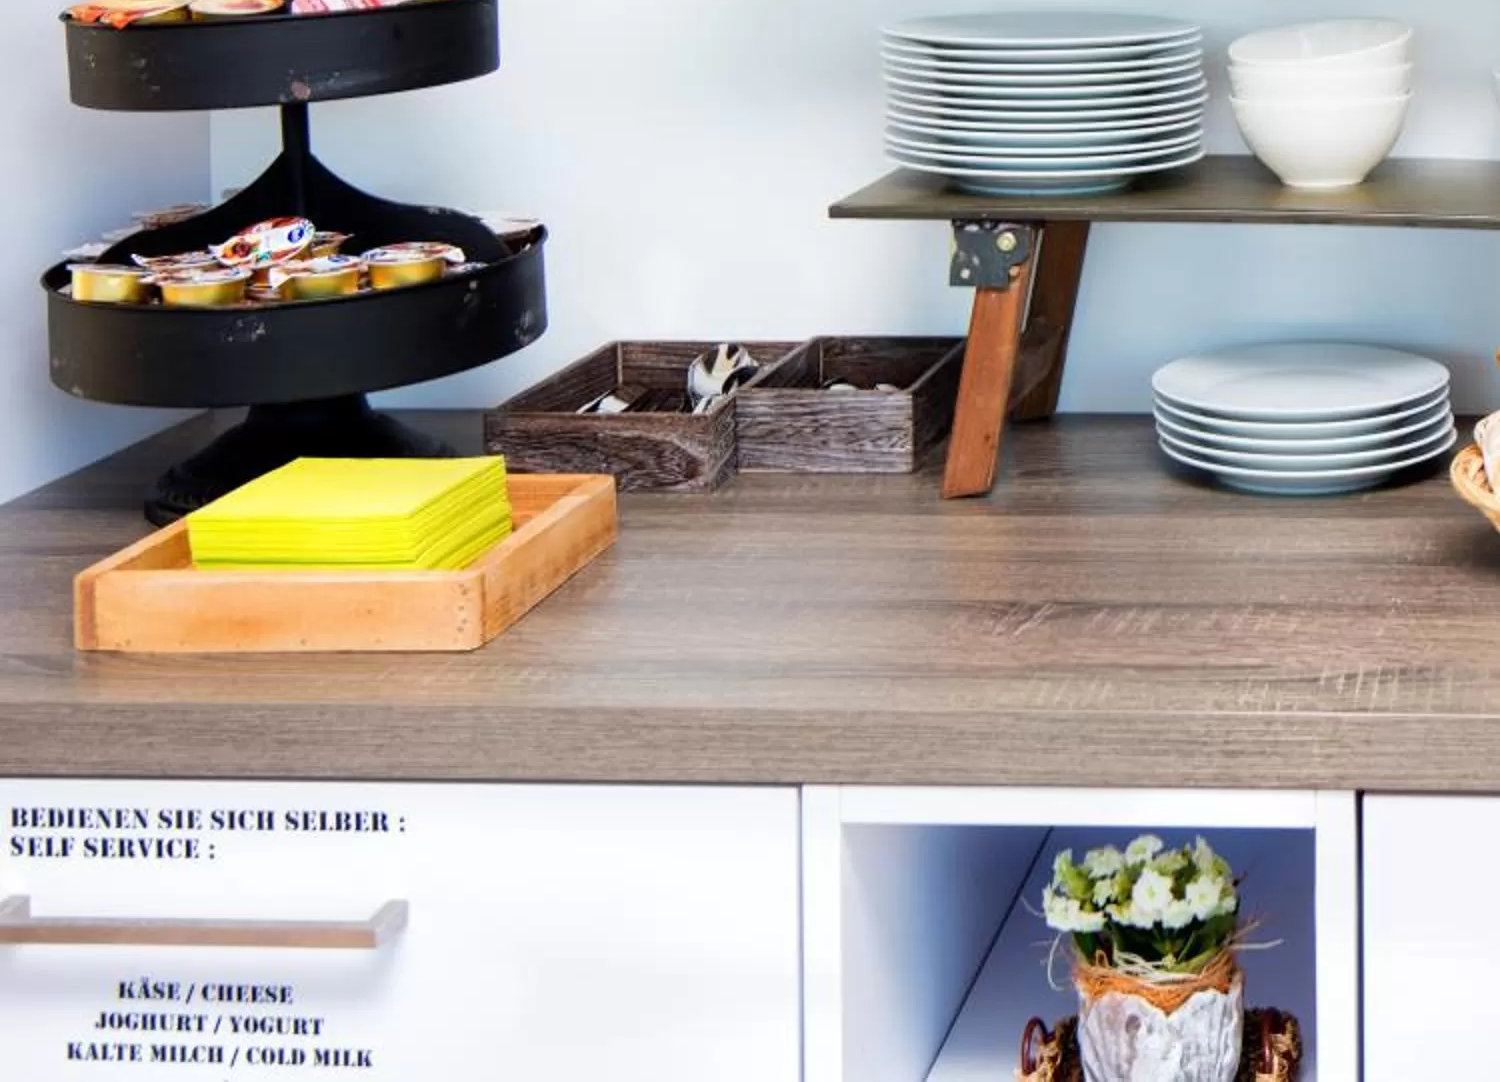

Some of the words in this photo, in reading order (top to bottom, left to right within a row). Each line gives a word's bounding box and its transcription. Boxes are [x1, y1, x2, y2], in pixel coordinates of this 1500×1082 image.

[10, 806, 149, 830] BEDIENEN
[156, 808, 203, 831] SIE
[209, 809, 275, 832] SICH
[283, 810, 390, 834] SELBER
[9, 836, 76, 858] SELF
[82, 837, 200, 860] SERVICE
[117, 976, 181, 1002] KÄSE
[200, 982, 295, 1005] CHEESE
[94, 1010, 208, 1033] JOGHURT
[229, 1014, 325, 1037] YOGURT
[66, 1041, 144, 1062] KALTE
[149, 1043, 224, 1065] MILCH
[245, 1045, 306, 1067] COLD
[312, 1048, 373, 1069] MILK
